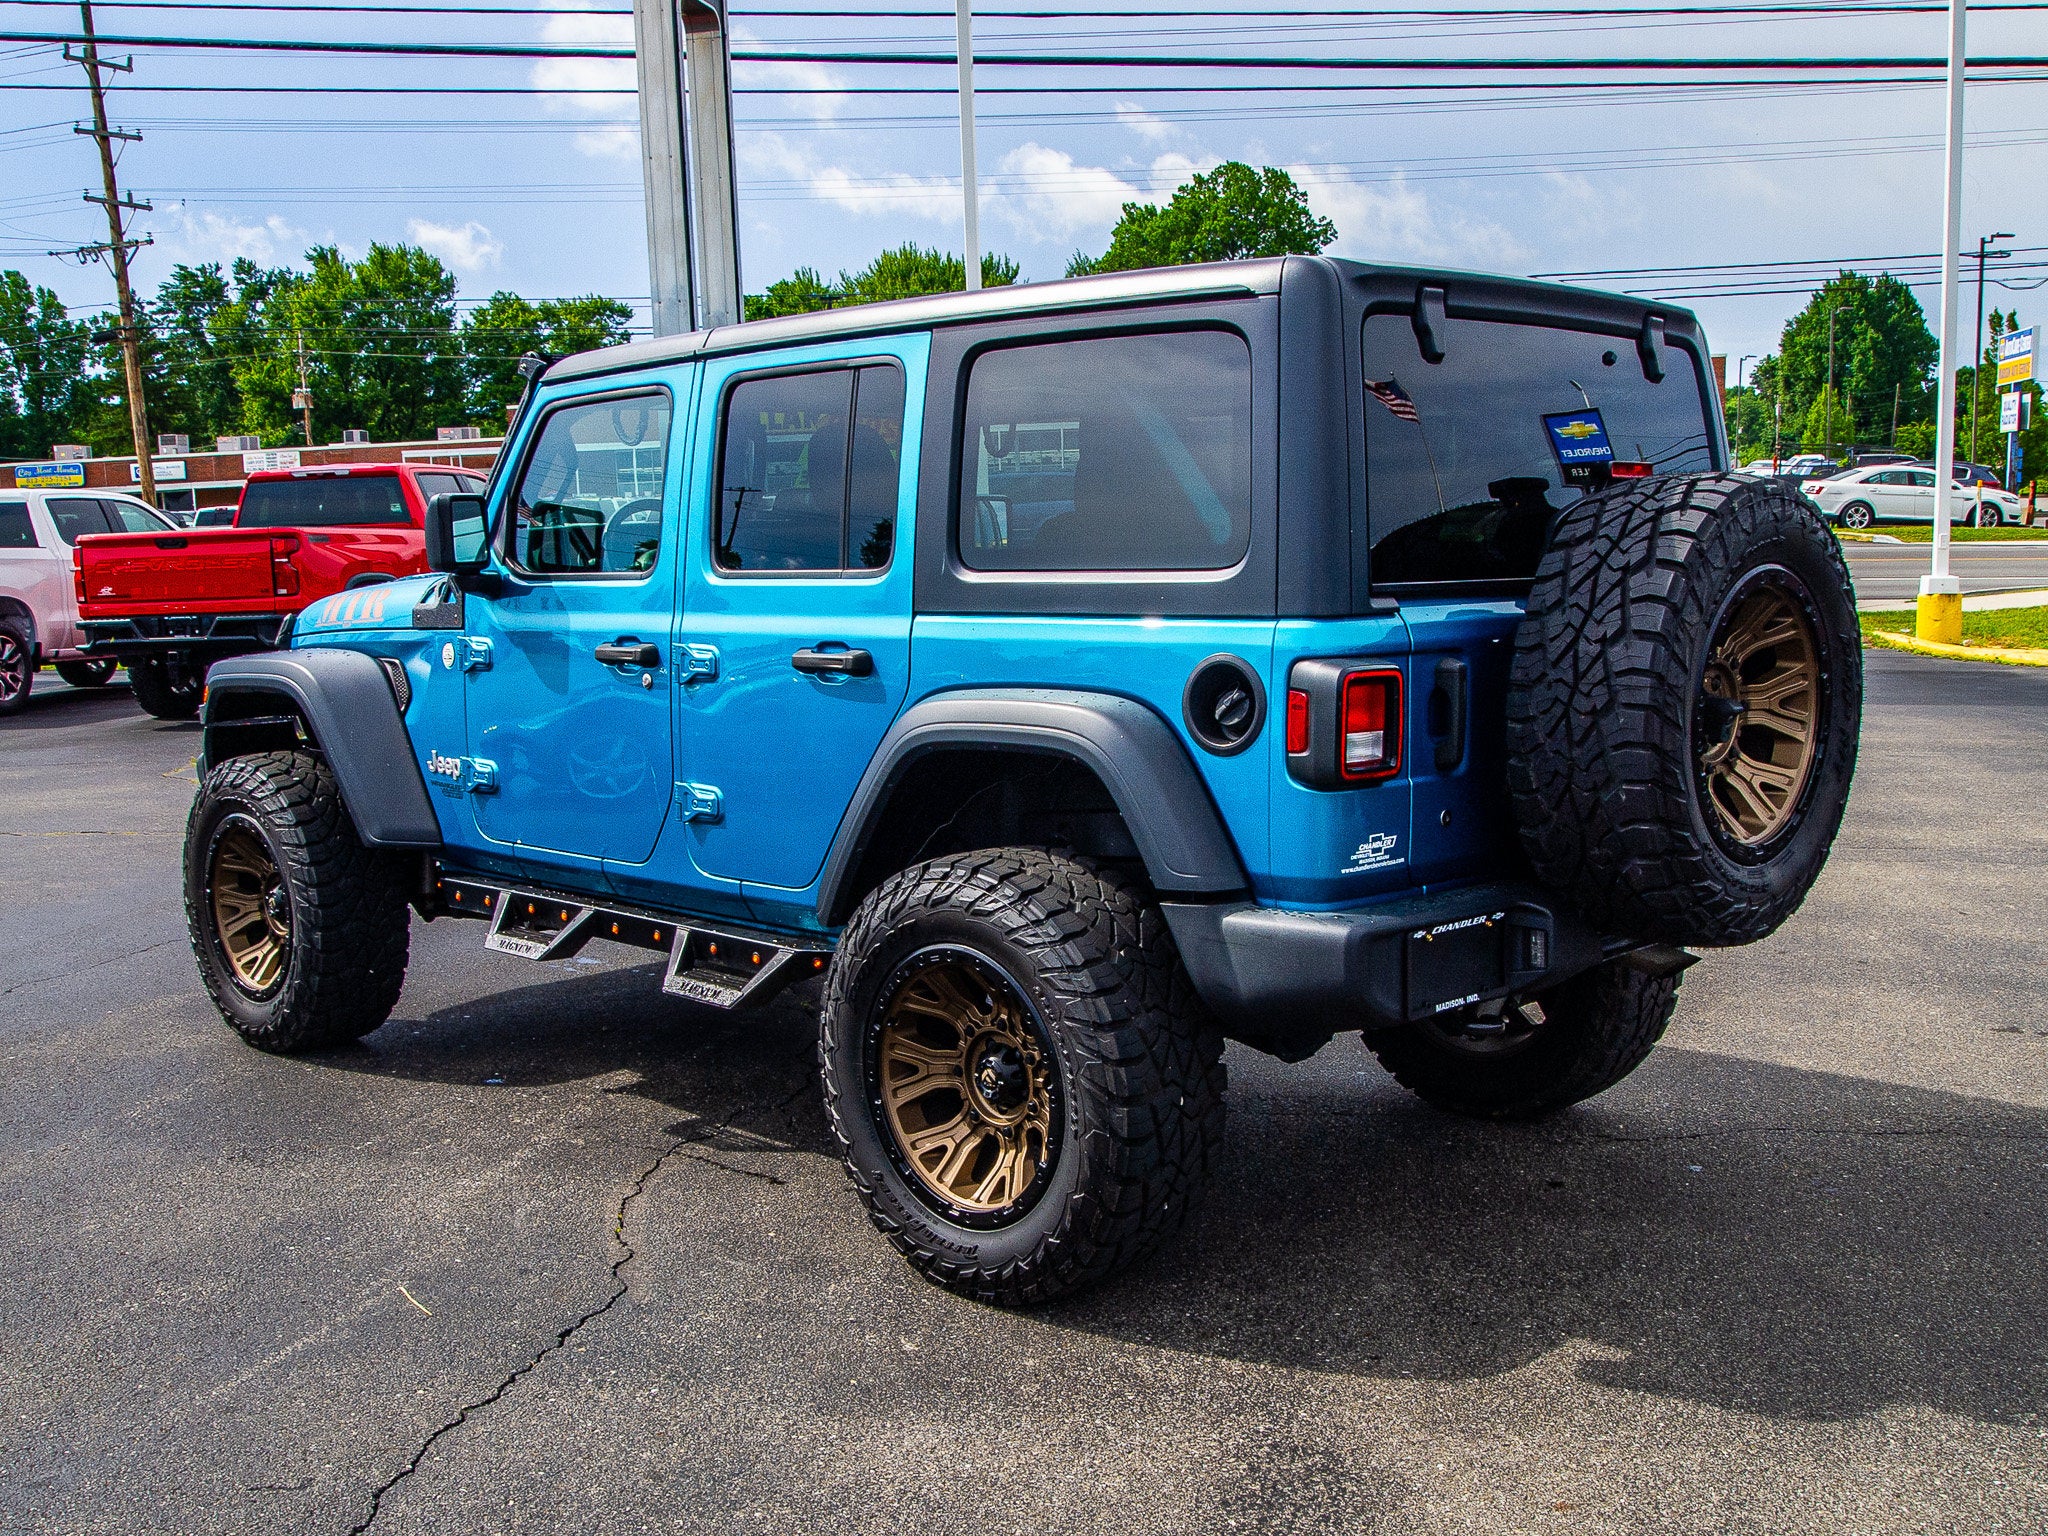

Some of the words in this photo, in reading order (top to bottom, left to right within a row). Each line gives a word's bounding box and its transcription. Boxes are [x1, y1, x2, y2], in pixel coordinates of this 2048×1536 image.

[427, 750, 460, 780] Jeep
[1358, 839, 1392, 850] CHANDLER
[1432, 915, 1487, 934] CHANDLER
